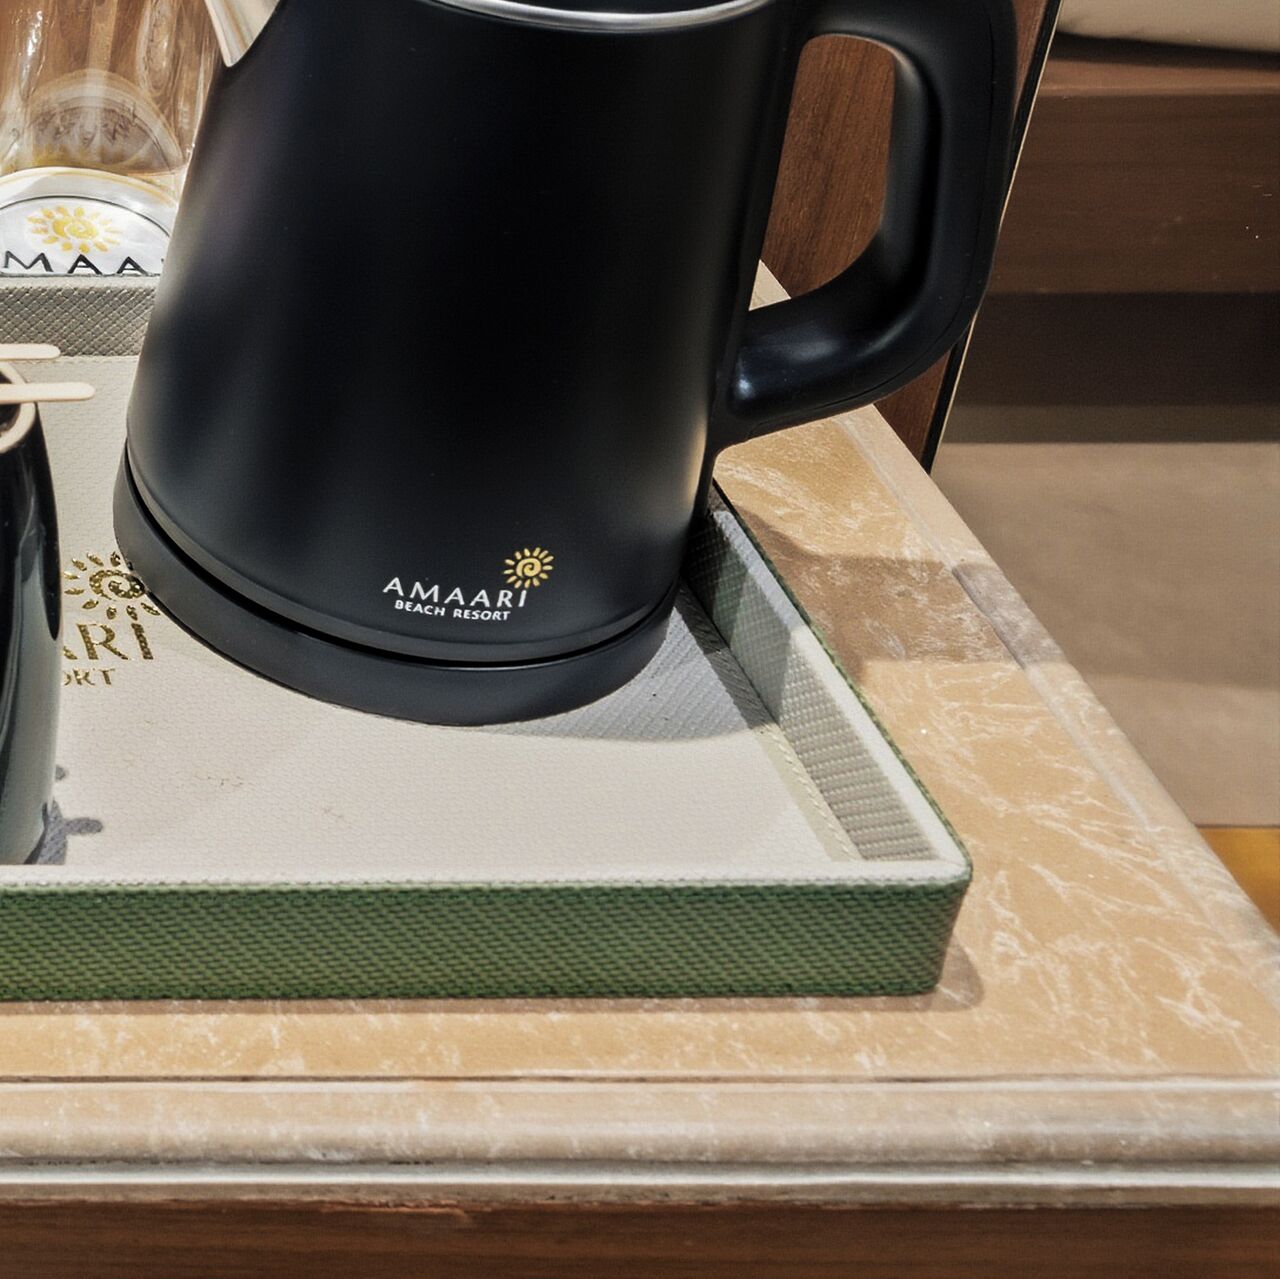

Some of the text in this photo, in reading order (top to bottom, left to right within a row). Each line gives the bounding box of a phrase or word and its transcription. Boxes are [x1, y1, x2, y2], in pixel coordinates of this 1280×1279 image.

[382, 576, 528, 609] AMAARI
[394, 599, 511, 621] BEACH RESORT
